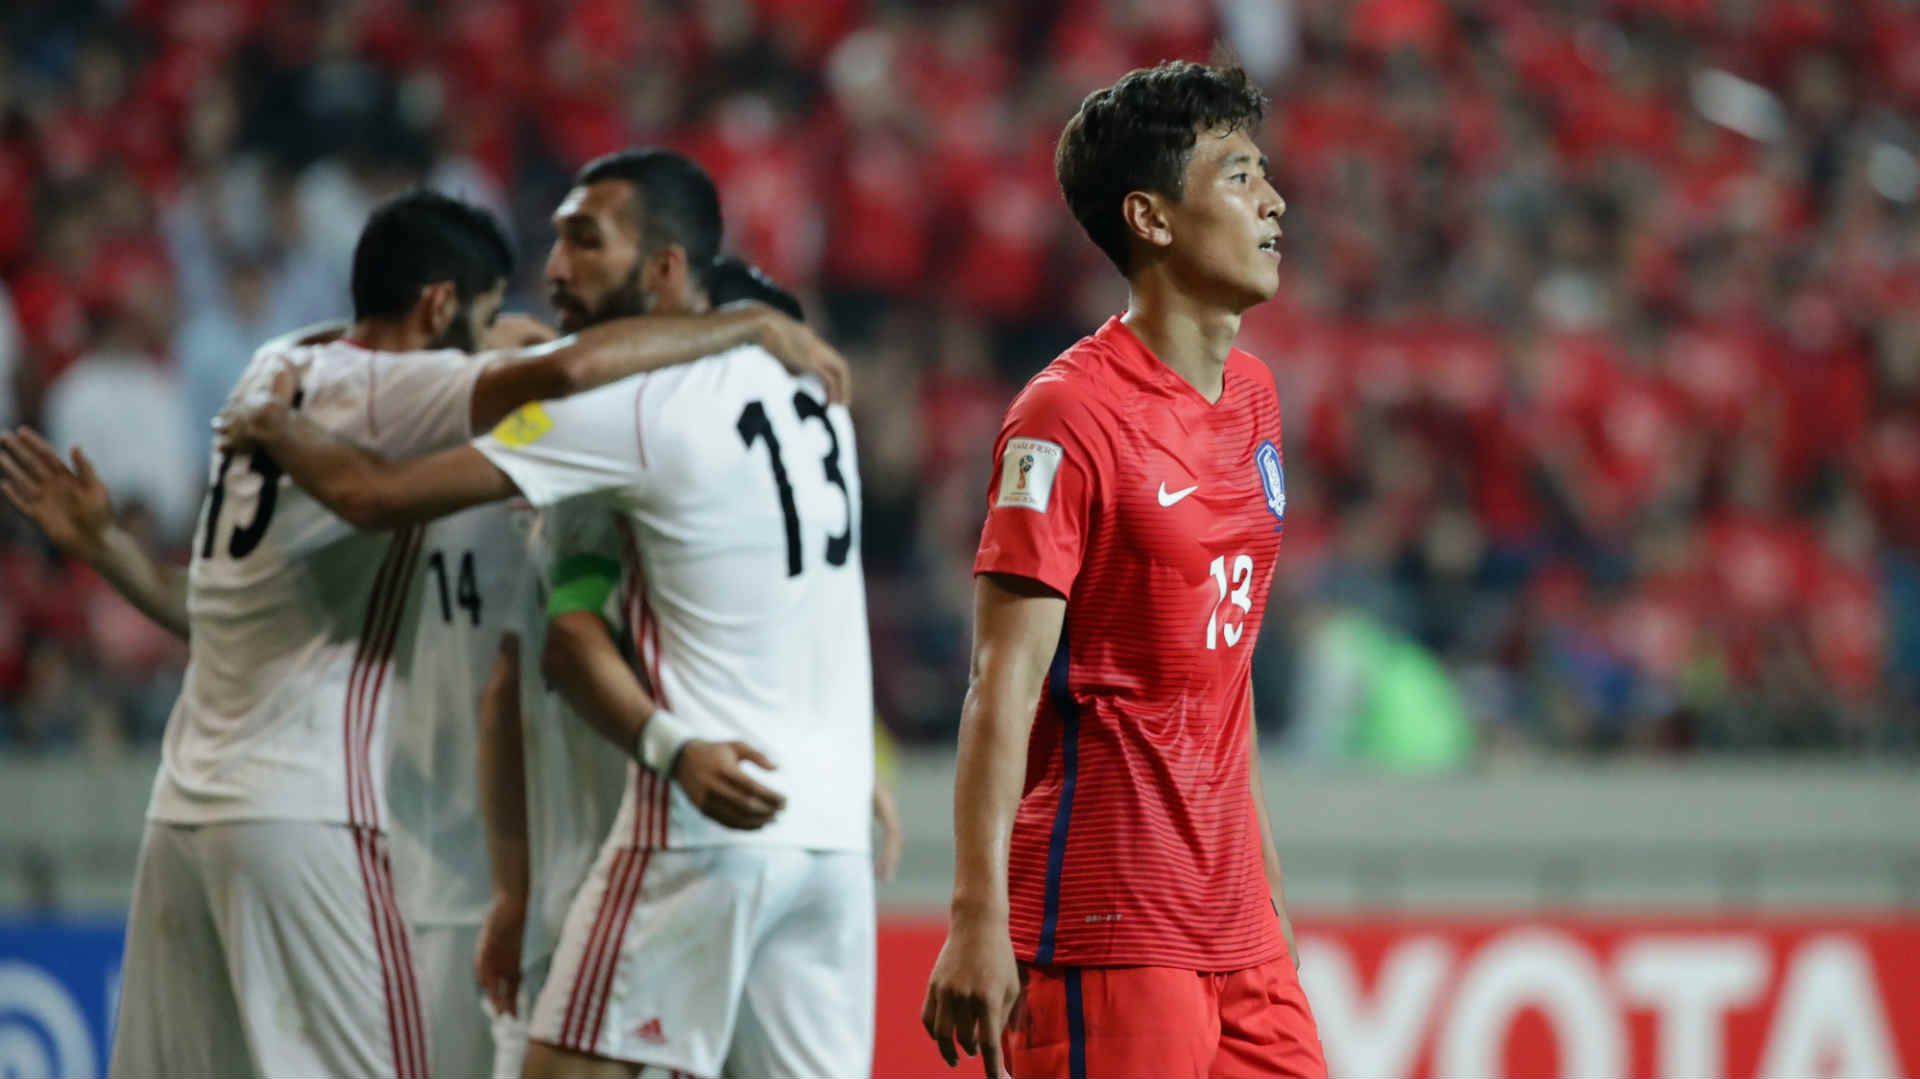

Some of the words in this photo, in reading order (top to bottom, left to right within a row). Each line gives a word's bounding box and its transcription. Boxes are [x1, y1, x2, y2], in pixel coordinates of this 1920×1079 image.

[737, 390, 852, 577] 13
[428, 550, 483, 627] 14
[1206, 554, 1253, 650] 13
